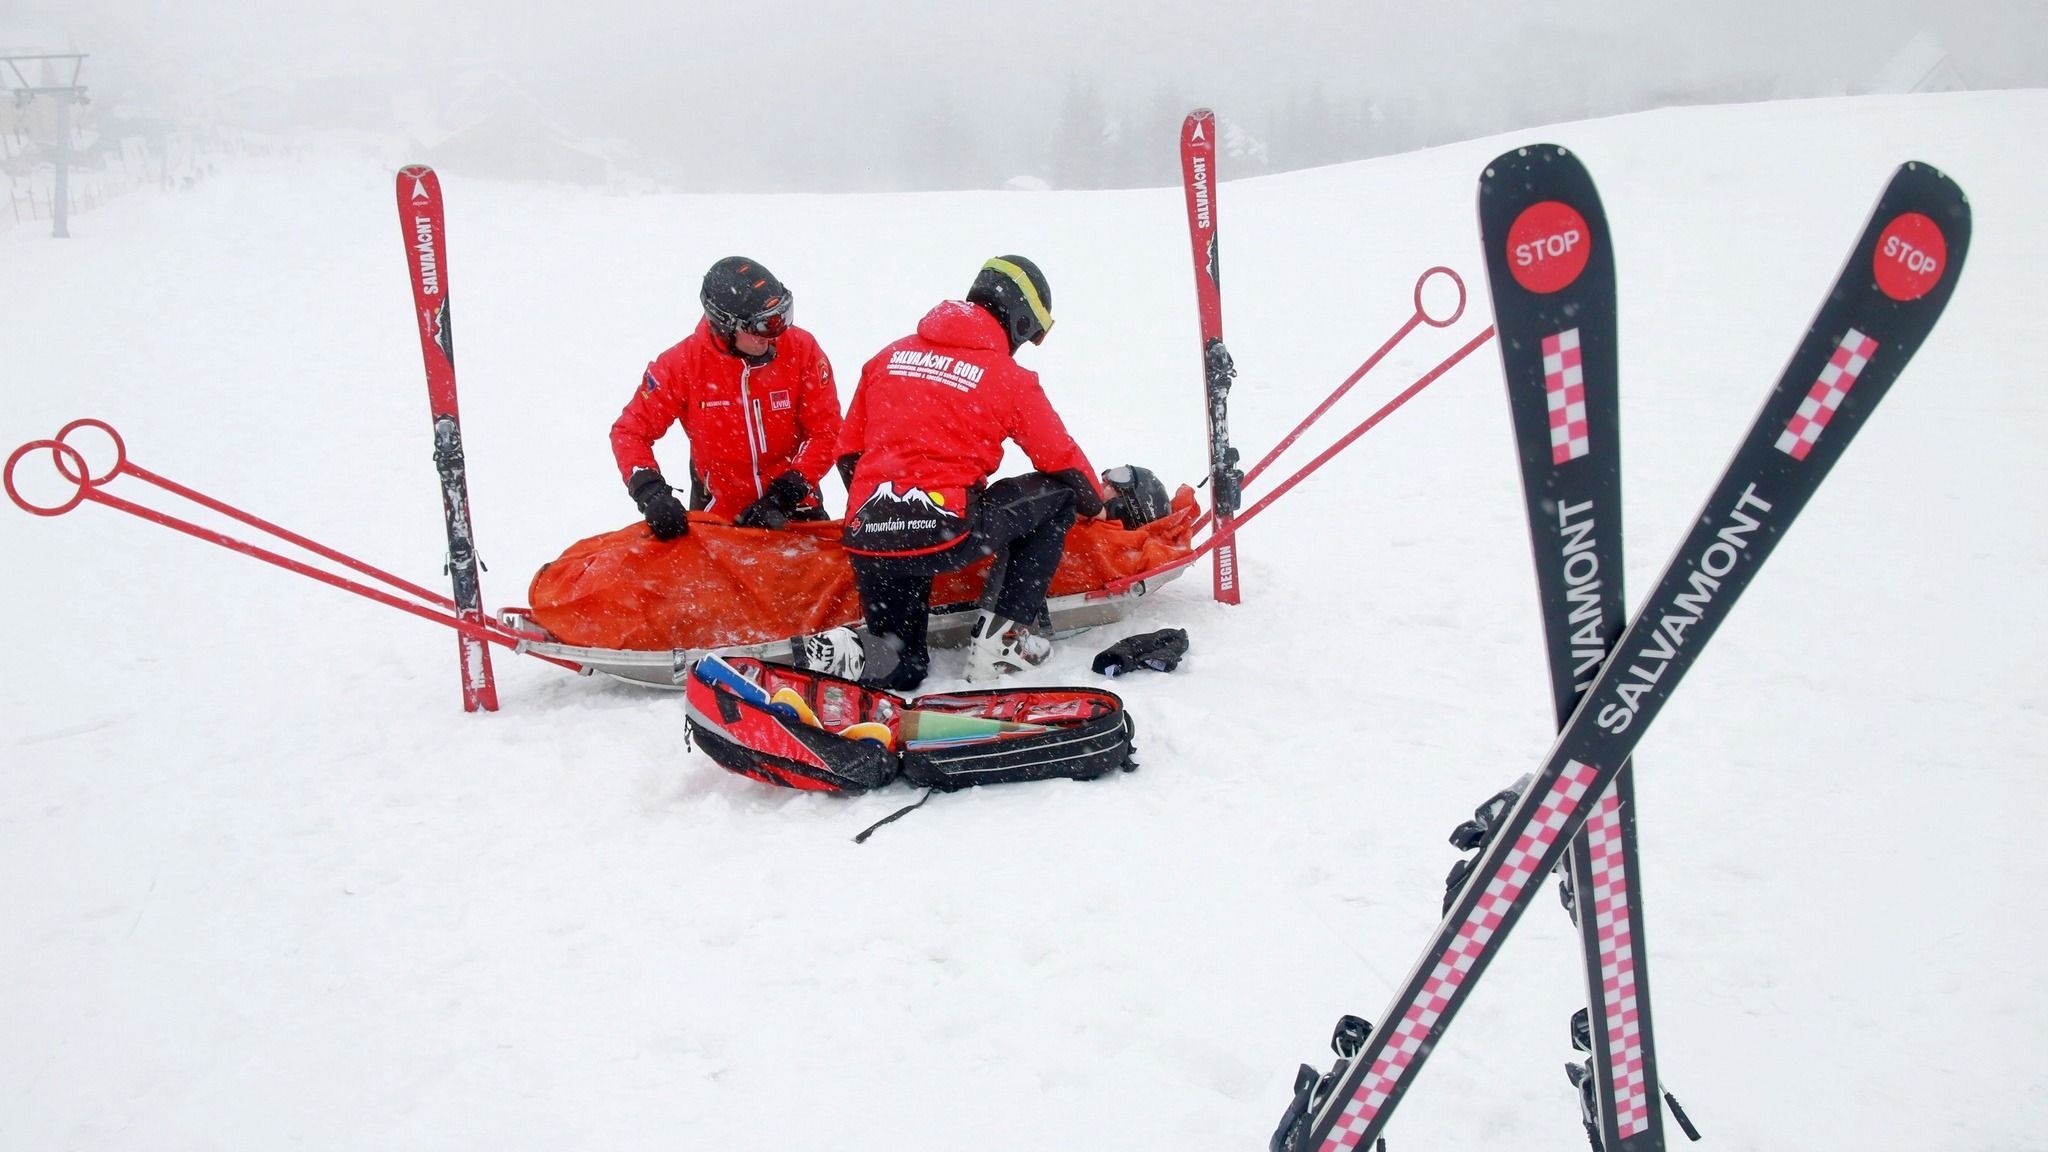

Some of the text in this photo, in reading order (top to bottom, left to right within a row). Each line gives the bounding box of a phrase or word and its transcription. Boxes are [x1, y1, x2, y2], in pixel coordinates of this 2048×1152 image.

[1192, 157, 1209, 228] SALVAMONT
[413, 216, 438, 295] SALVAMONT
[1515, 229, 1580, 267] STOP
[1883, 235, 1937, 277] STOP
[890, 350, 954, 371] SALVAMONT
[865, 517, 937, 533] mountain rescue
[1220, 545, 1233, 590] REGHIN
[1597, 482, 1773, 734] SALVAMONT
